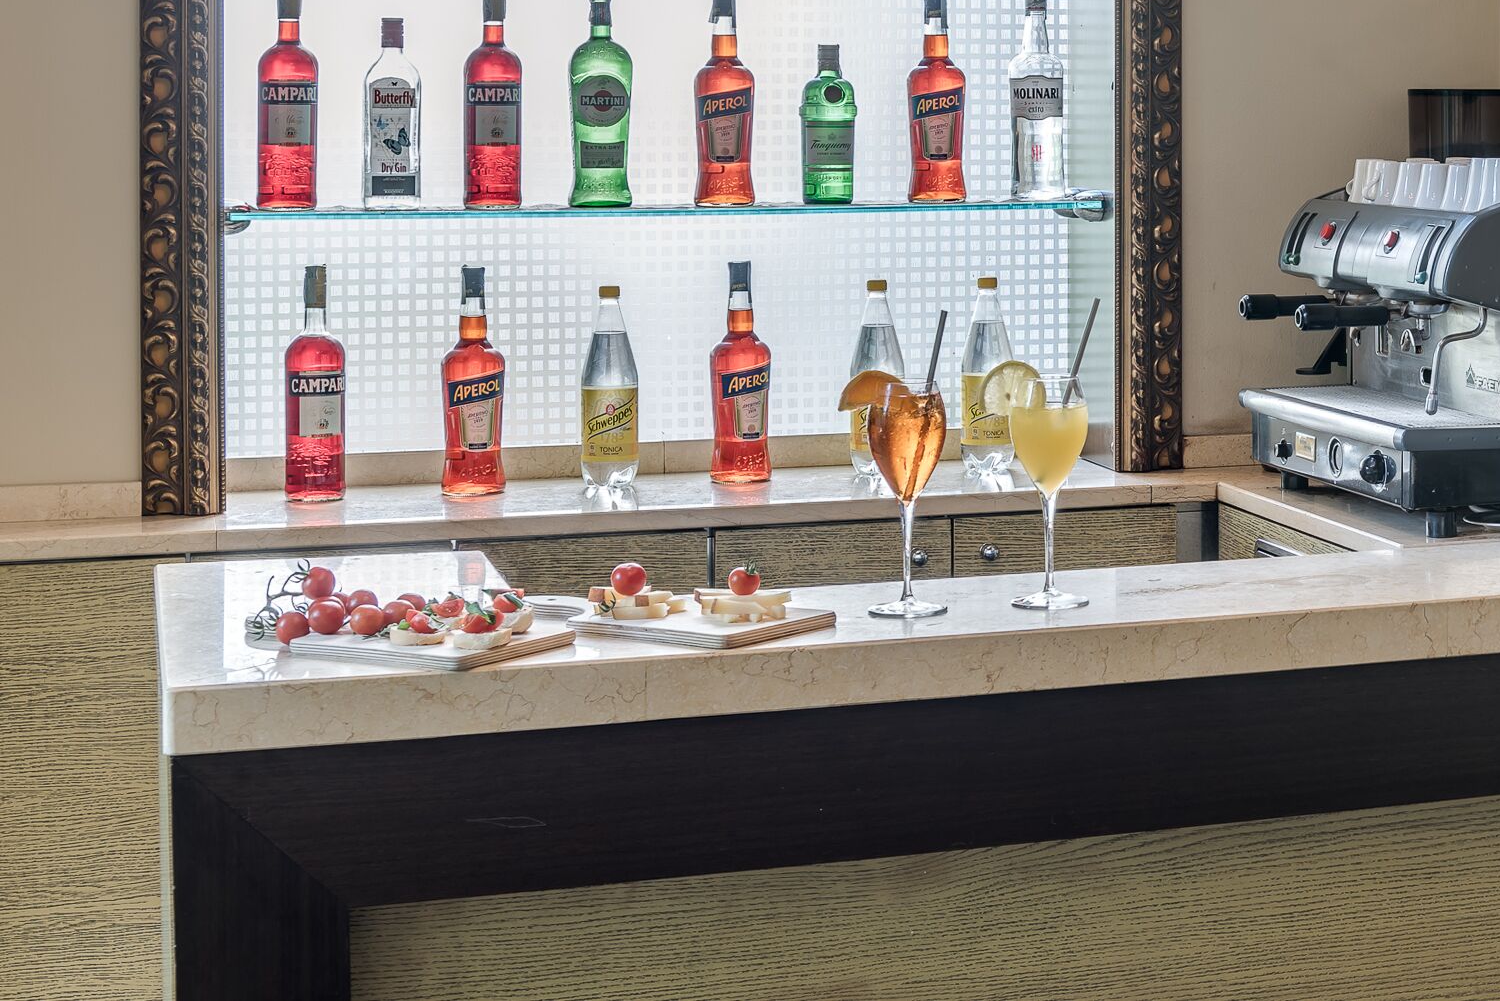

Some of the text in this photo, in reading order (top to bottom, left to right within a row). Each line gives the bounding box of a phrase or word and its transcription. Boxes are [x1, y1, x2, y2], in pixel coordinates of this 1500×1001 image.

[261, 86, 317, 101] CAMPARI
[374, 89, 415, 107] Butterfly
[582, 96, 625, 106] MARTINI
[1013, 87, 1060, 100] MOLINARI
[703, 95, 748, 116] APEROL
[916, 94, 960, 116] APEROL
[811, 139, 852, 151] Tanqueray
[381, 161, 407, 174] Dry Gin
[453, 378, 500, 402] APEROL
[588, 402, 634, 435] Schweppes
